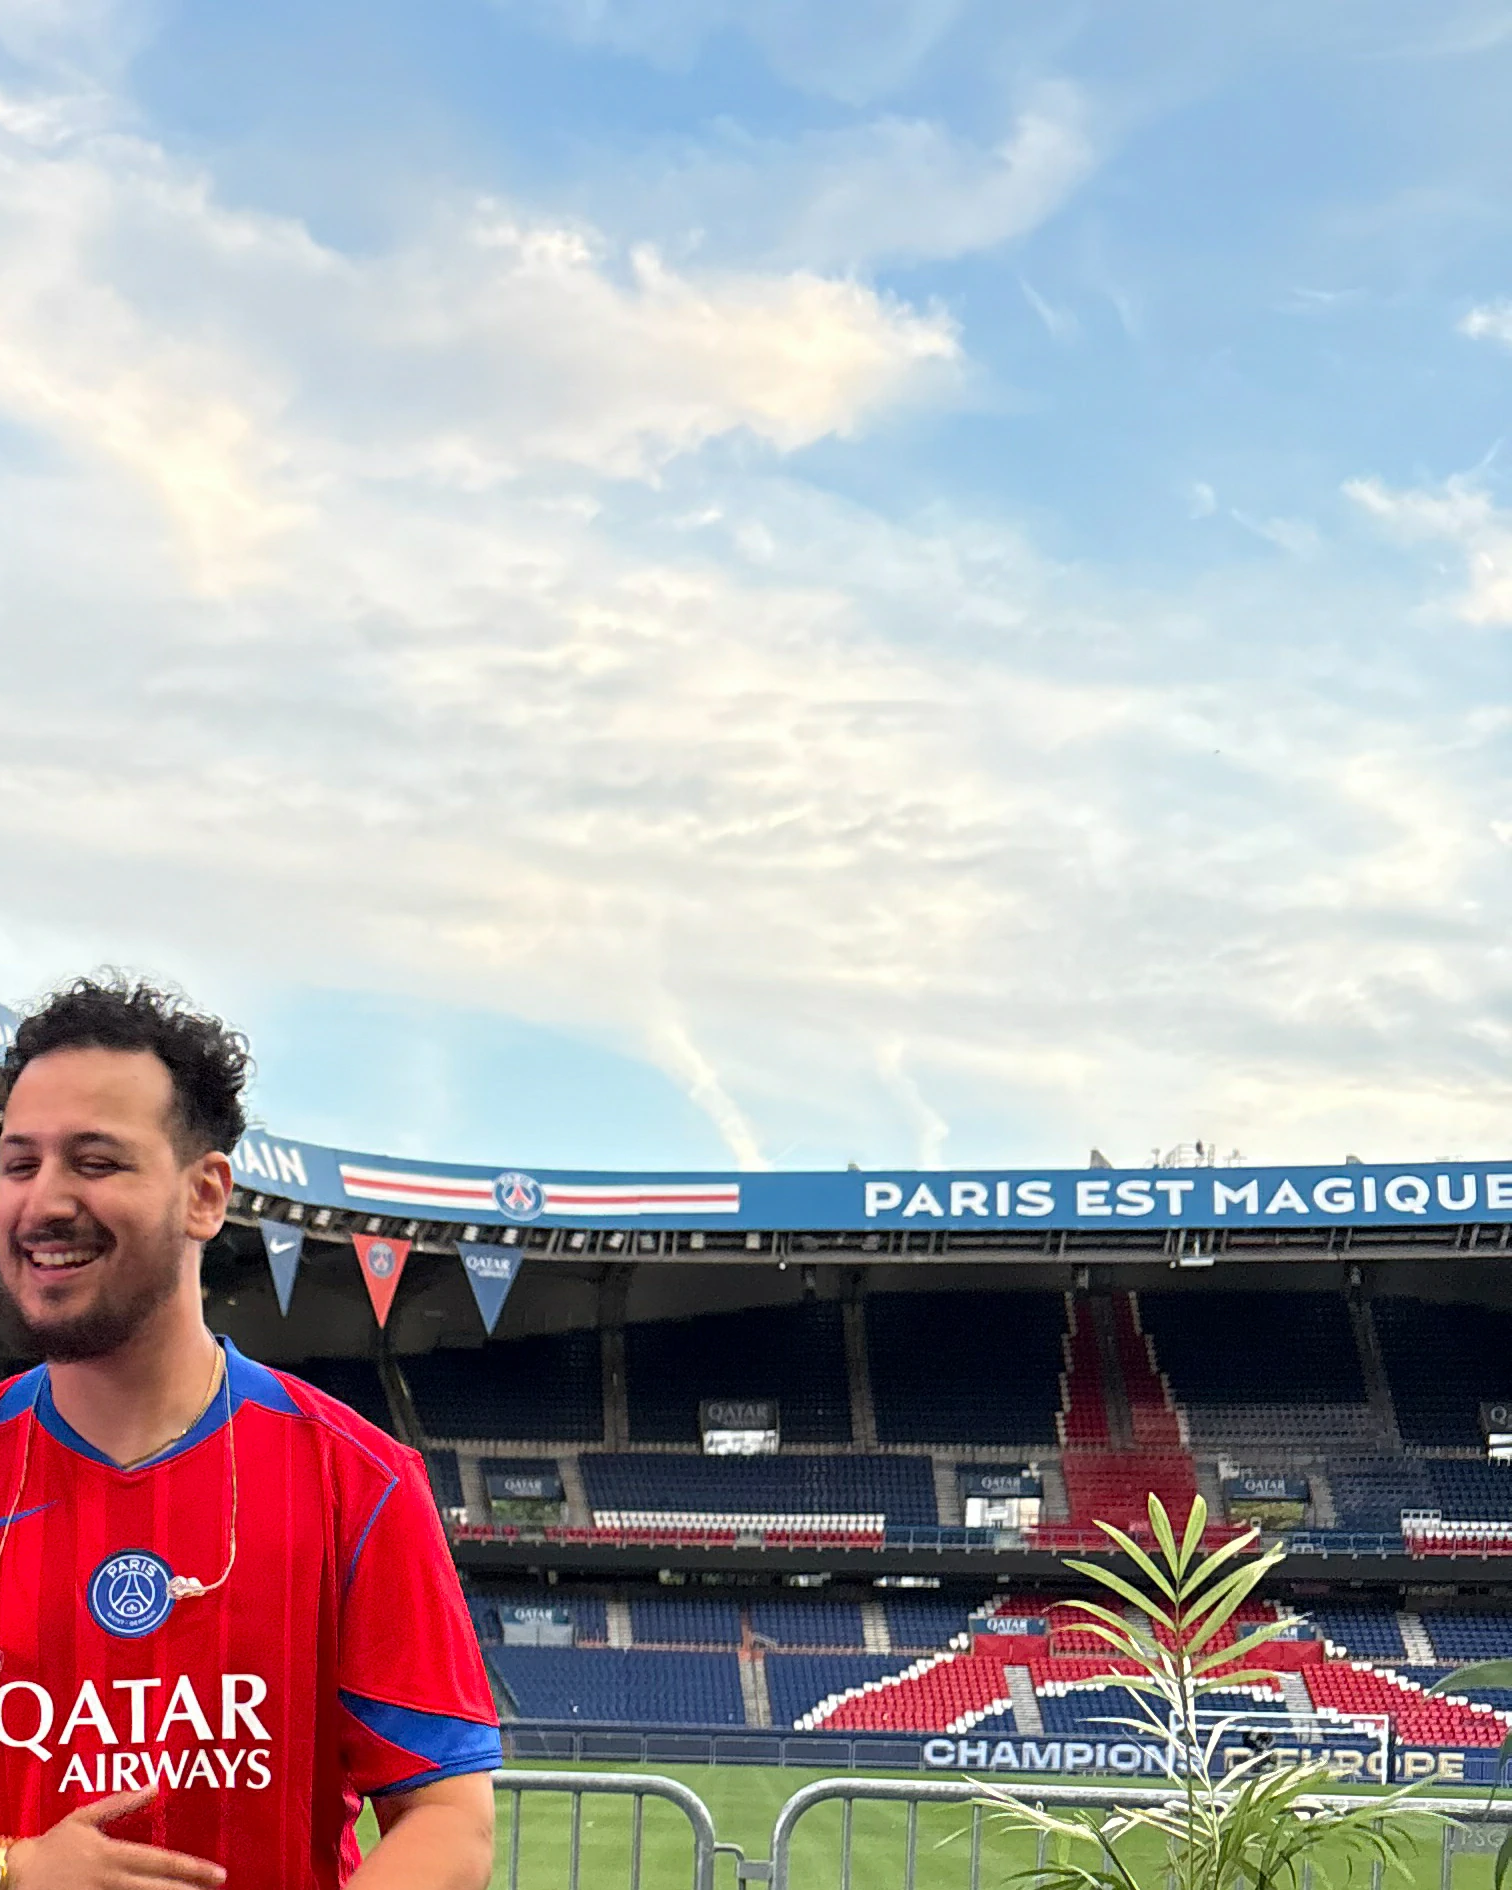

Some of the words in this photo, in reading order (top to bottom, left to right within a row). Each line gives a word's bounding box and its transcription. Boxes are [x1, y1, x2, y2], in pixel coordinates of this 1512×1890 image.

[864, 1180, 1056, 1217] PARIS
[1076, 1180, 1195, 1216] EST
[1212, 1174, 1512, 1215] MAGIQUE
[466, 1255, 511, 1271] QATAR
[708, 1402, 769, 1421] QATAR
[981, 1476, 1021, 1491] QATAR
[1244, 1479, 1286, 1492] QATAR
[107, 1559, 157, 1578] PARIS
[514, 1608, 553, 1622] QATAR
[986, 1617, 1028, 1632] QATAR
[57, 1748, 272, 1793] AIRWAYS
